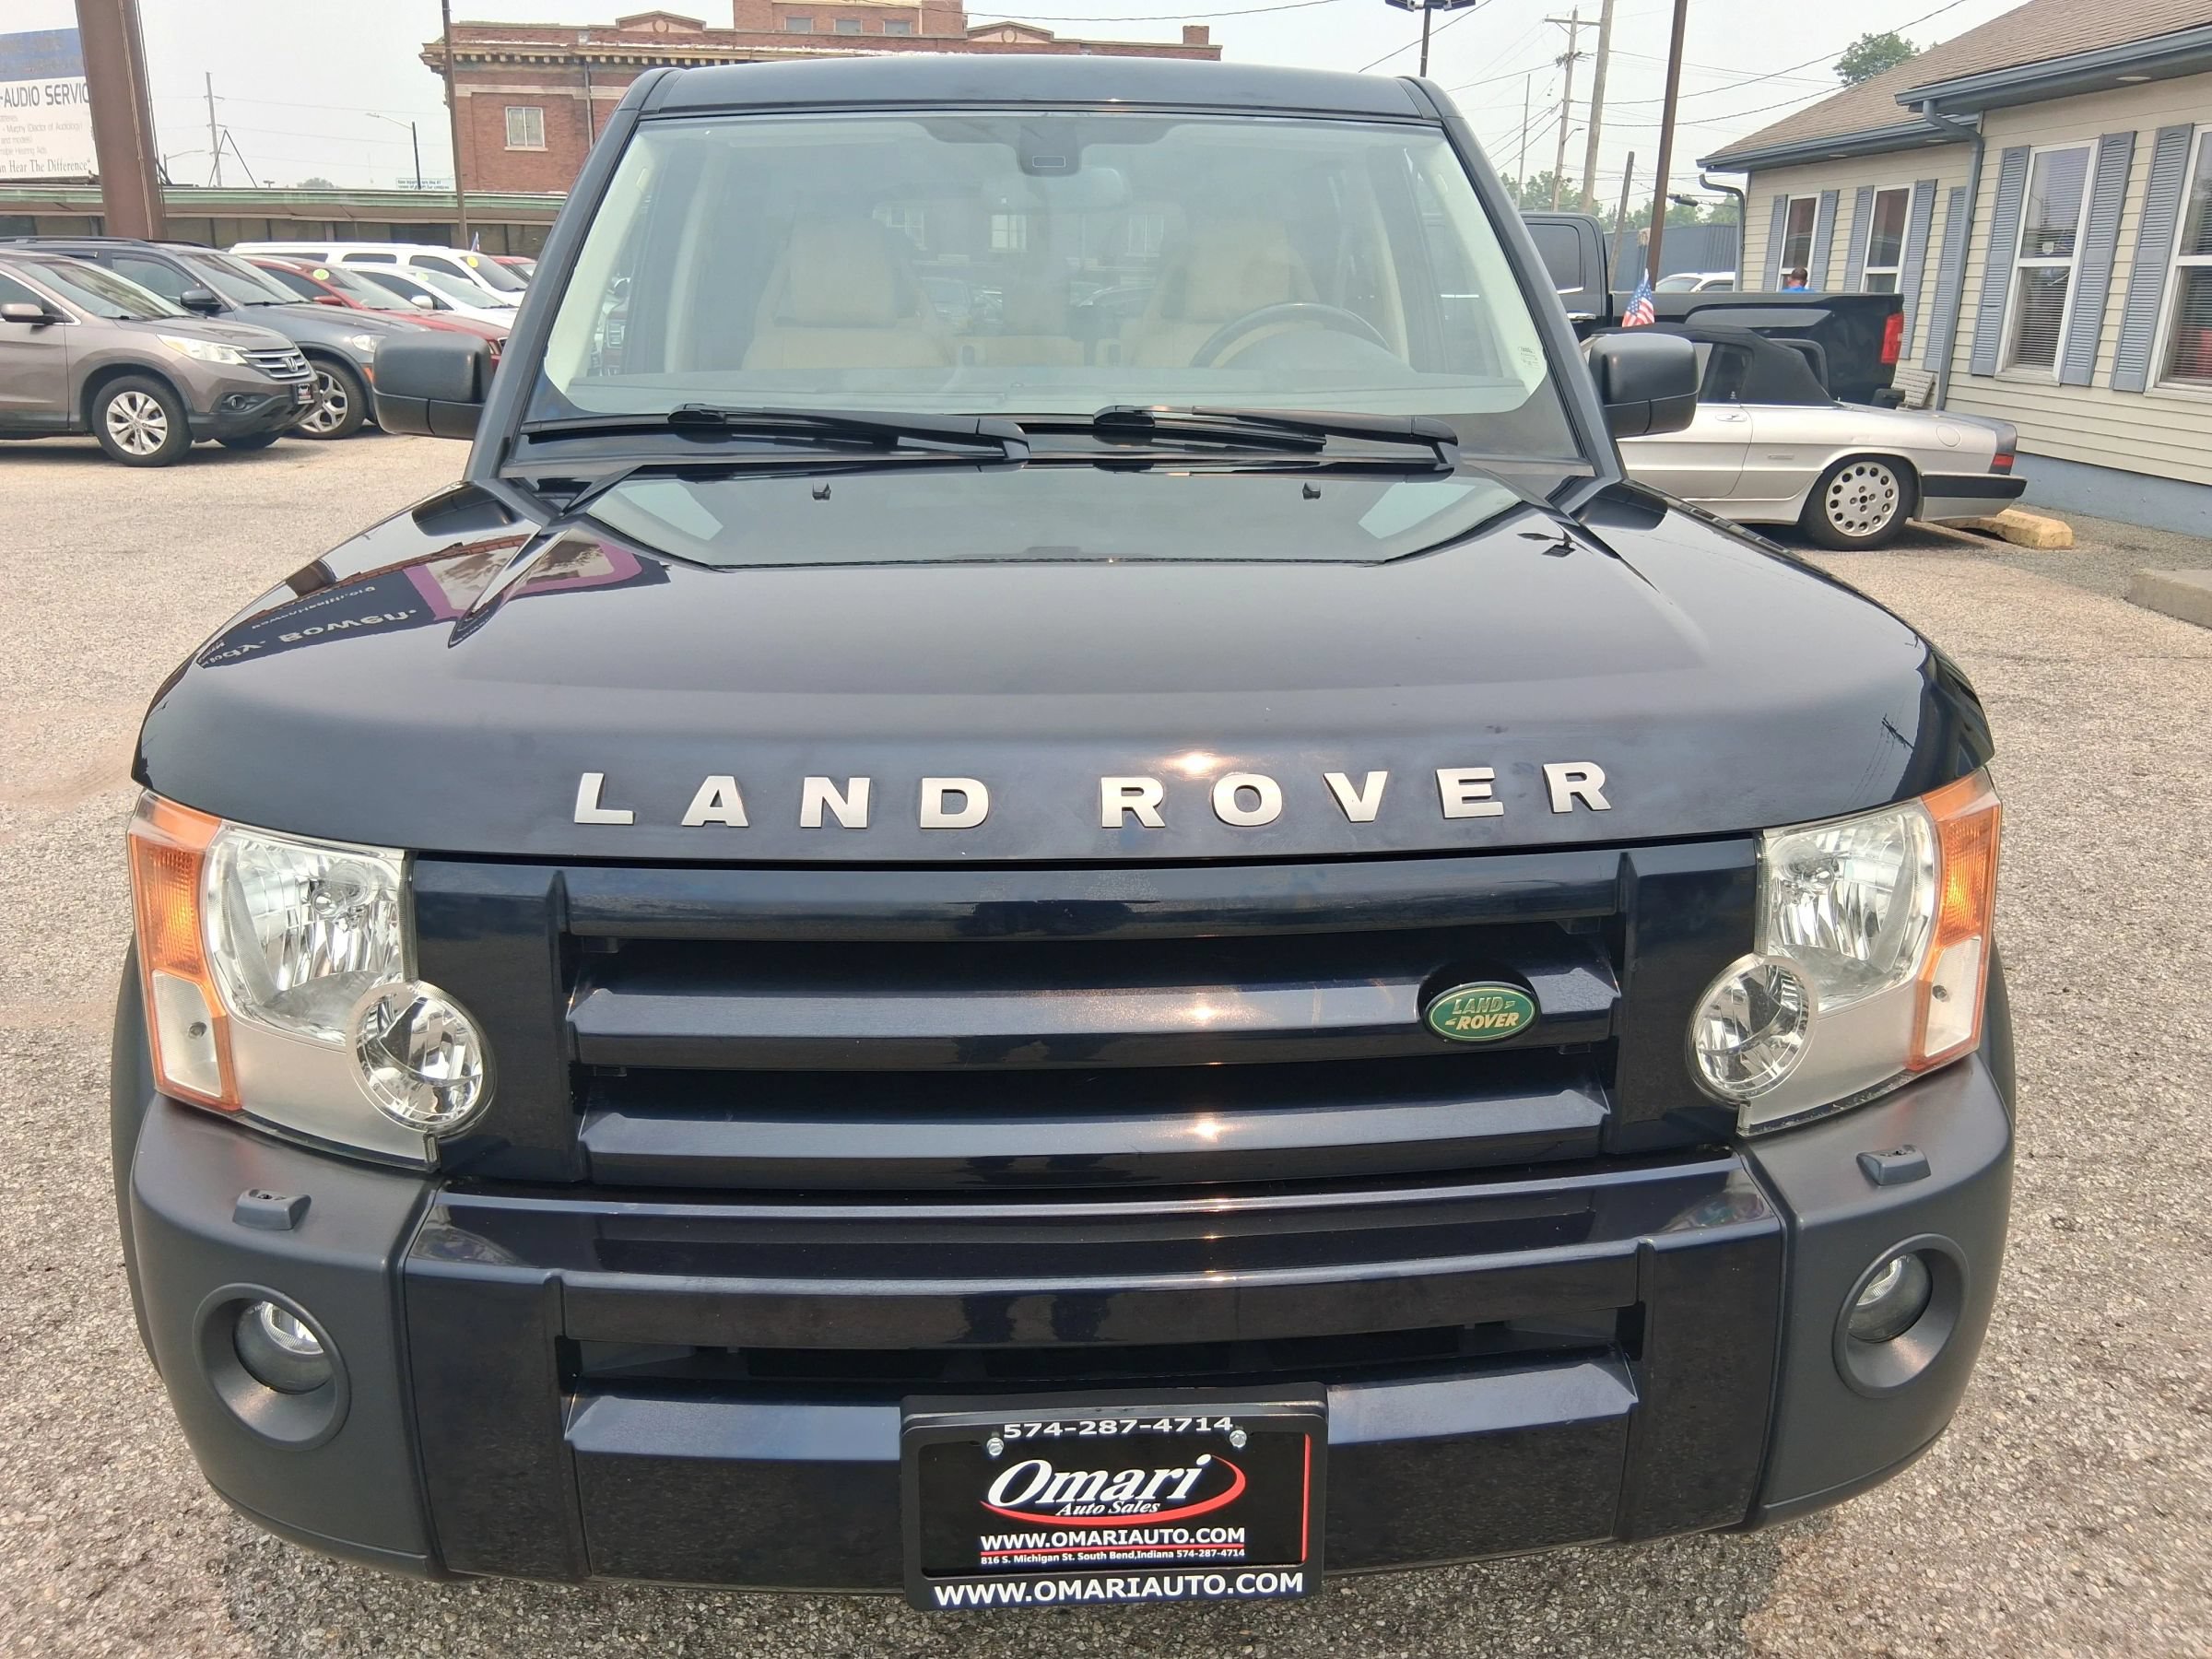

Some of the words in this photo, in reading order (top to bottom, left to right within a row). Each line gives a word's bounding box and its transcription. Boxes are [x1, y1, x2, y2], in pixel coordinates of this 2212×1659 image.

[44, 82, 90, 106] SERVIC
[8, 159, 28, 173] Hear
[29, 159, 44, 172] The
[572, 771, 990, 830] LAND
[1100, 760, 1612, 830] ROVER
[1452, 996, 1503, 1015] LAND
[1455, 1012, 1520, 1030] ROVER
[1003, 1417, 1233, 1439] 574-287-4714
[986, 1453, 1213, 1509] Omari
[1055, 1501, 1106, 1517] Auto
[1108, 1500, 1161, 1514] Sales
[980, 1527, 1245, 1551] WWW.OMARIAUTO.COM
[981, 1556, 1000, 1565] 816
[1002, 1555, 1011, 1564] S.
[1013, 1554, 1060, 1564] Michigan
[1062, 1552, 1076, 1561] St.
[1077, 1551, 1107, 1561] South
[1176, 1548, 1245, 1559] 574-287-4714
[934, 1572, 1304, 1606] WWW.OMARIAUTO.COM
